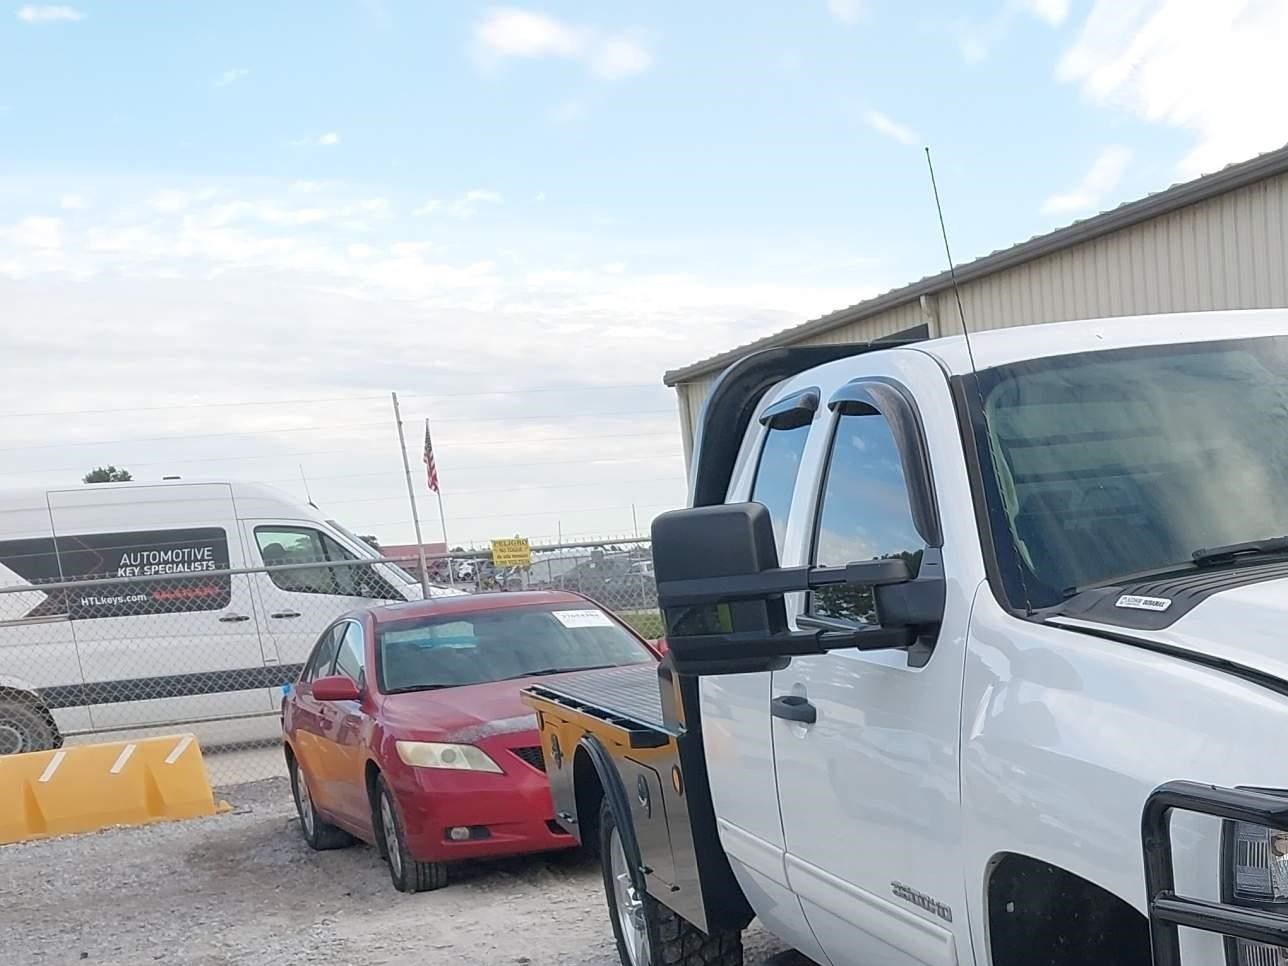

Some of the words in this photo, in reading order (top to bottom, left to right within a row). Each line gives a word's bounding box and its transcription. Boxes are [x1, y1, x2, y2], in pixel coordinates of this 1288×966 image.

[119, 547, 213, 566] AUTOMOTIVE
[117, 567, 140, 577] KEY
[144, 561, 215, 576] SPECIALISTS
[81, 593, 147, 606] HTLkeys.com
